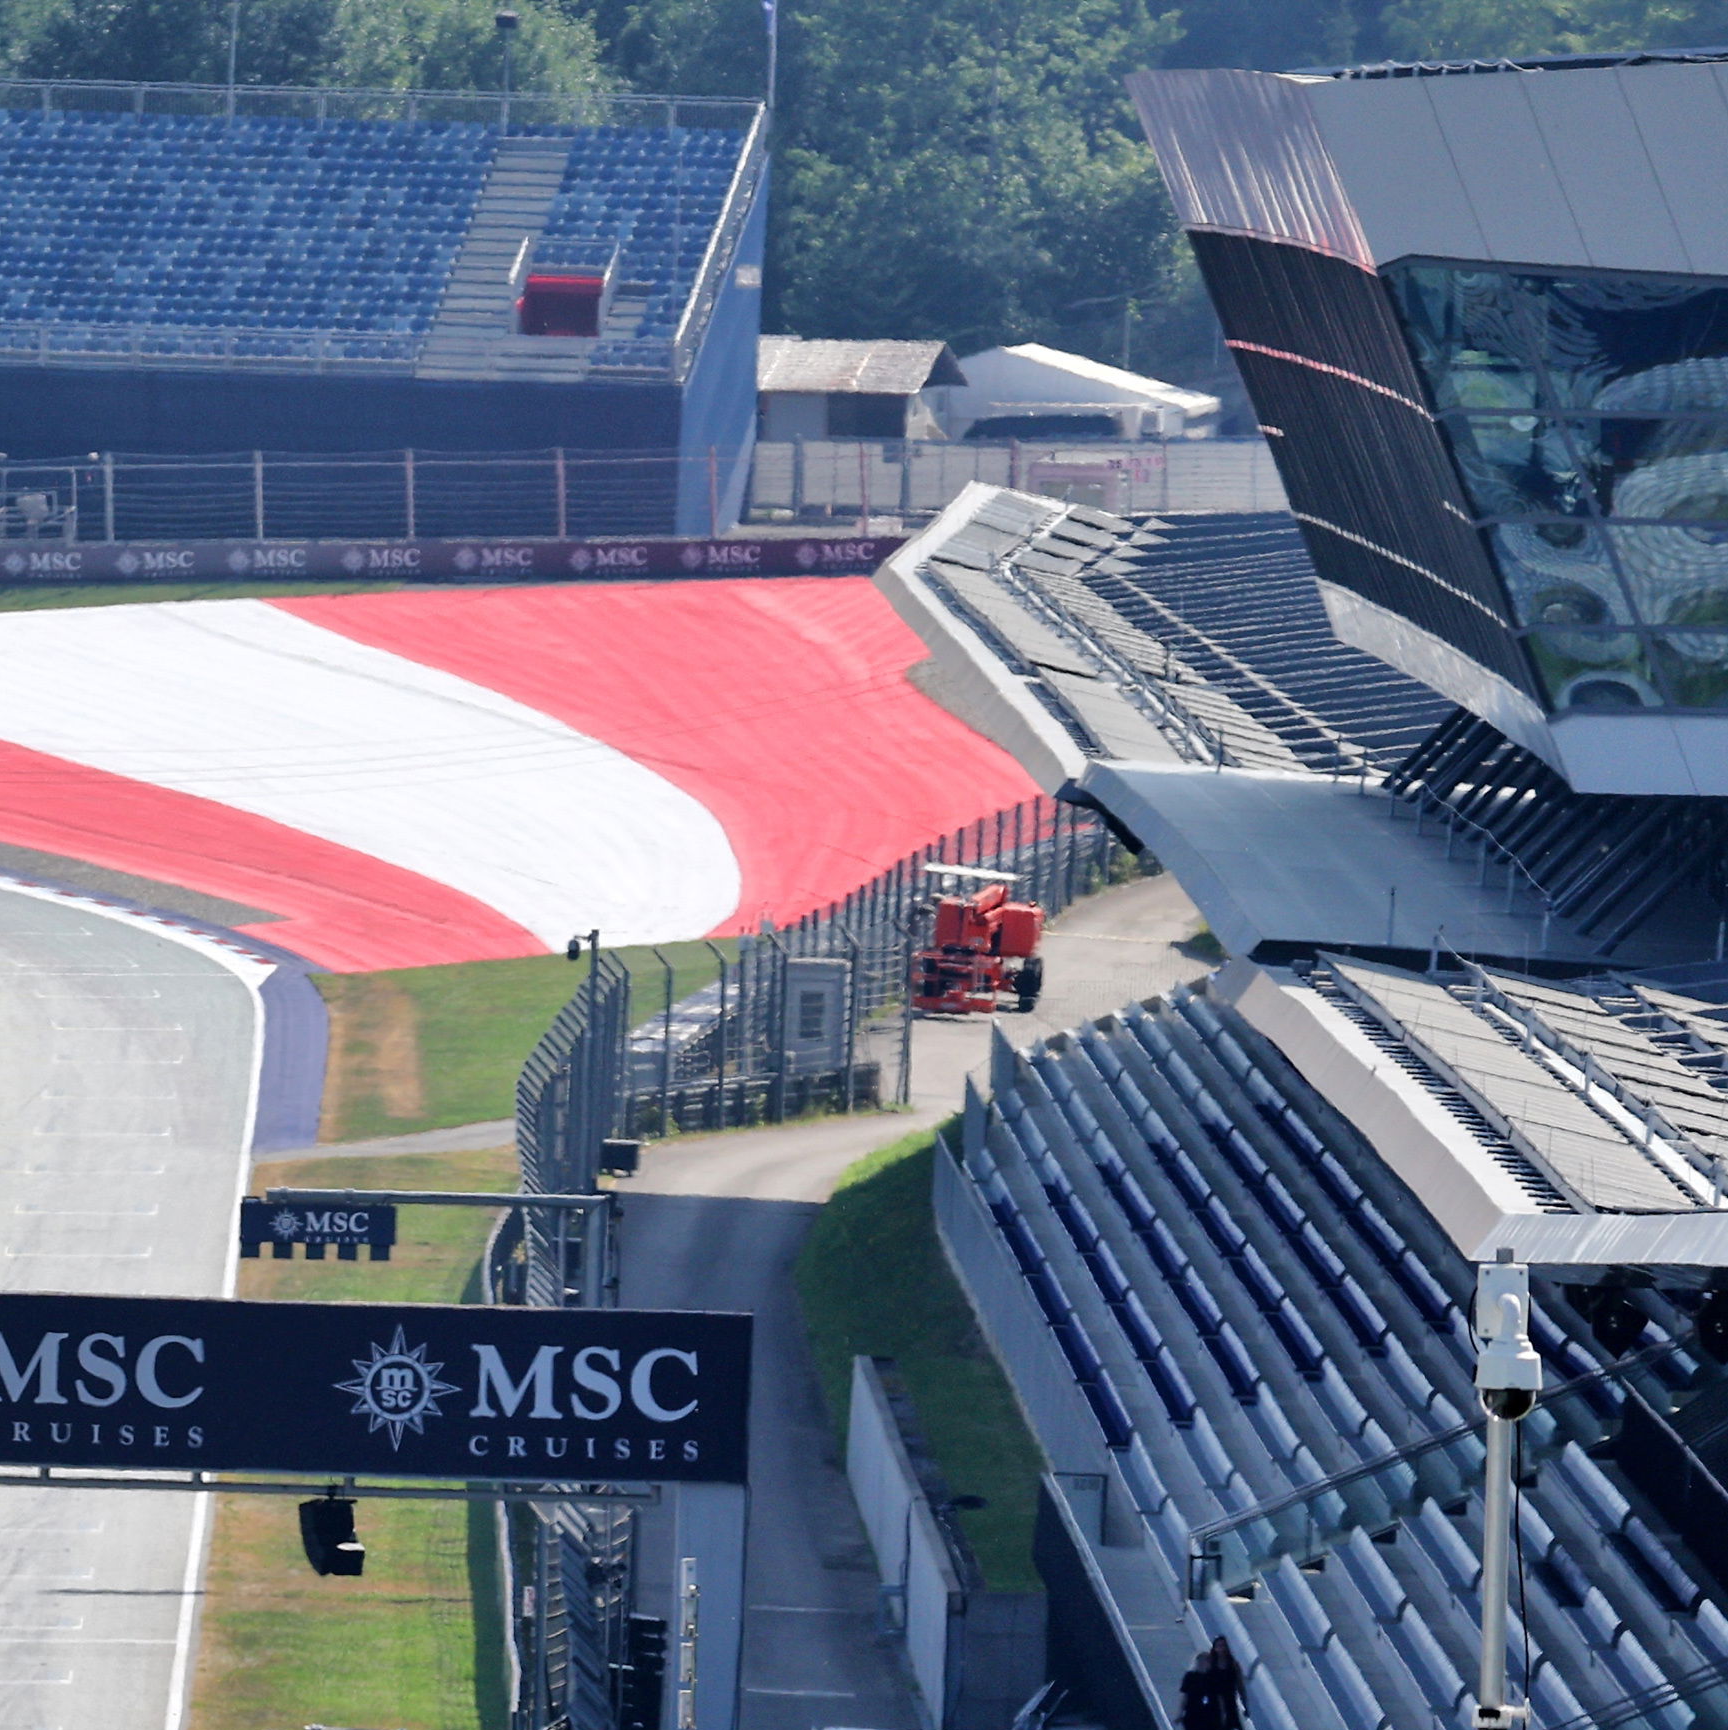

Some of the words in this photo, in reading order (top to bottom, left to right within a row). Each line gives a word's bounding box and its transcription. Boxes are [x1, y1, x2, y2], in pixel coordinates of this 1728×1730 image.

[29, 551, 82, 571] MSC
[143, 551, 195, 569] MSC
[254, 549, 306, 569] MSC
[368, 549, 421, 568] MSC
[481, 547, 533, 568] MSC
[595, 547, 648, 566] MSC
[708, 545, 760, 564] MSC
[822, 542, 875, 562] MSC
[305, 1211, 369, 1233] MSC
[470, 1343, 700, 1423] MSC
[470, 1434, 700, 1462] CRUISES
